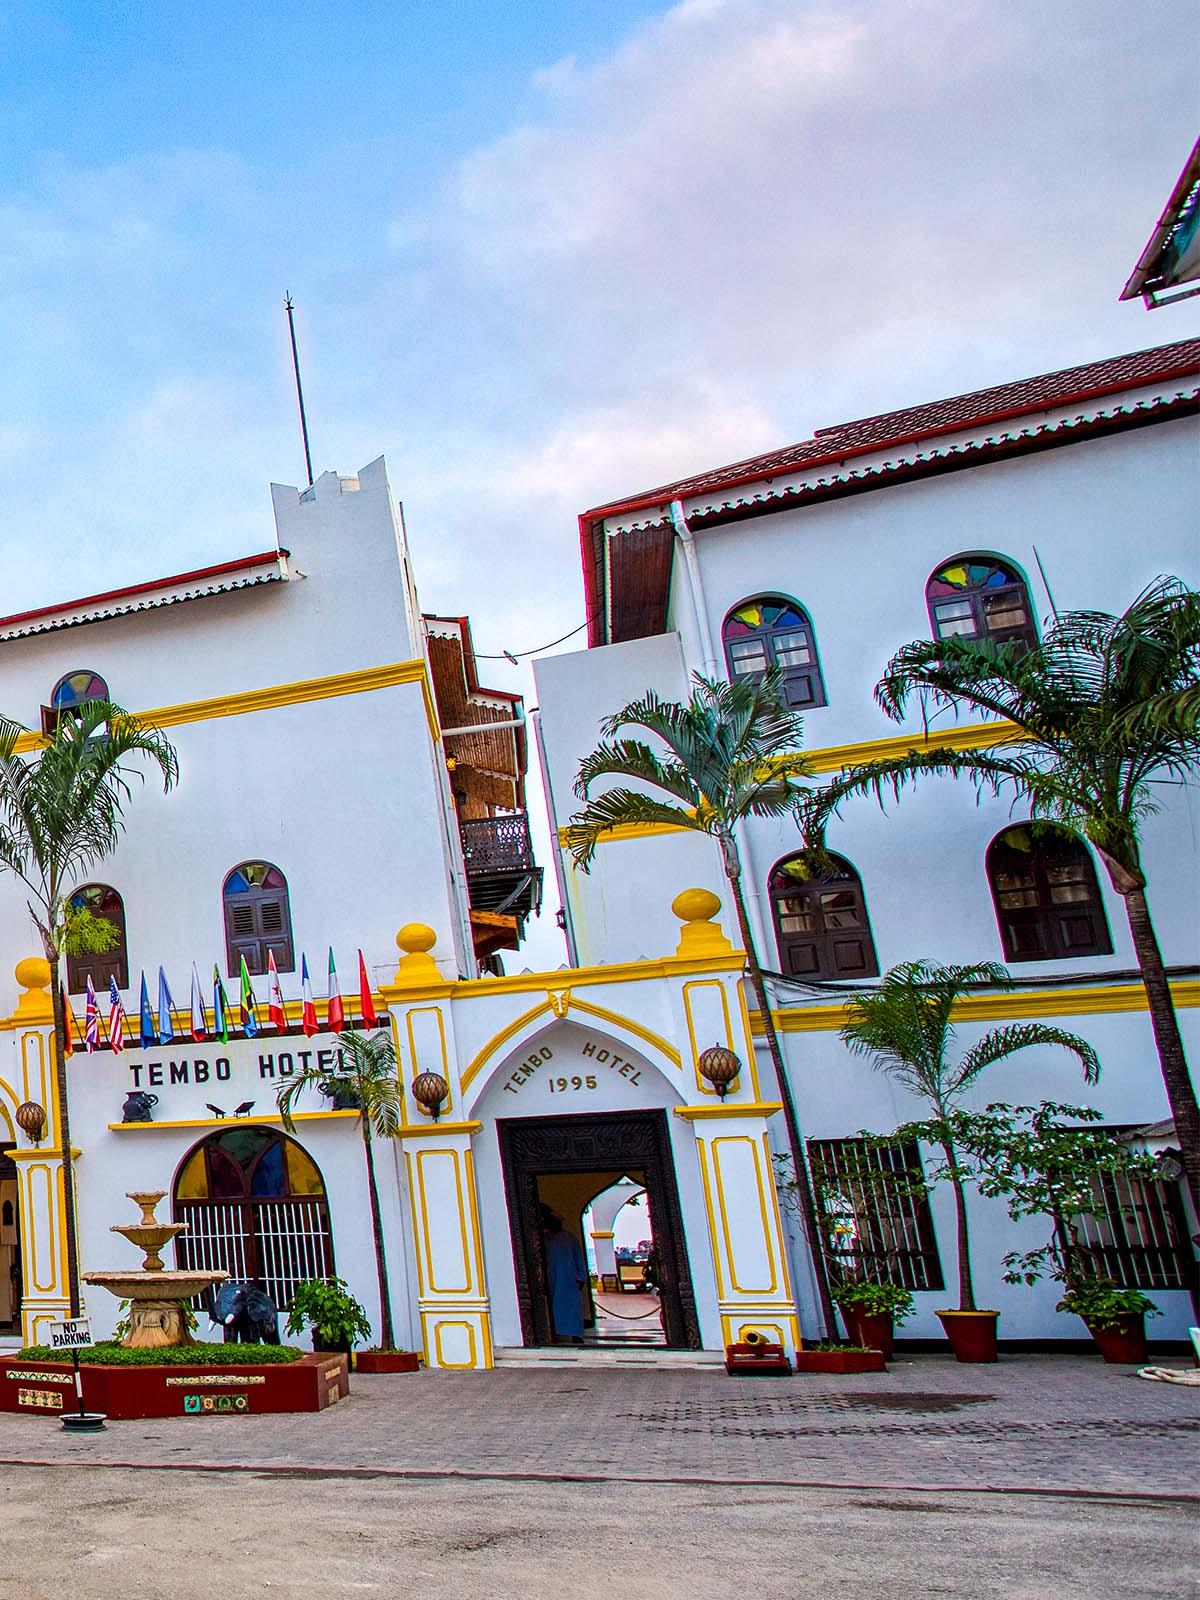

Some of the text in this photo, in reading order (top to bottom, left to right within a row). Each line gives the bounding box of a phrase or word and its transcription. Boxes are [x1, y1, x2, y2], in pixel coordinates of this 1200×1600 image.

[130, 1049, 356, 1087] TEMBO HOTEL
[503, 1042, 642, 1094] TEMBO HOTEL
[548, 1075, 597, 1093] 1995
[63, 1321, 77, 1333] NO
[52, 1332, 91, 1346] PARKING
